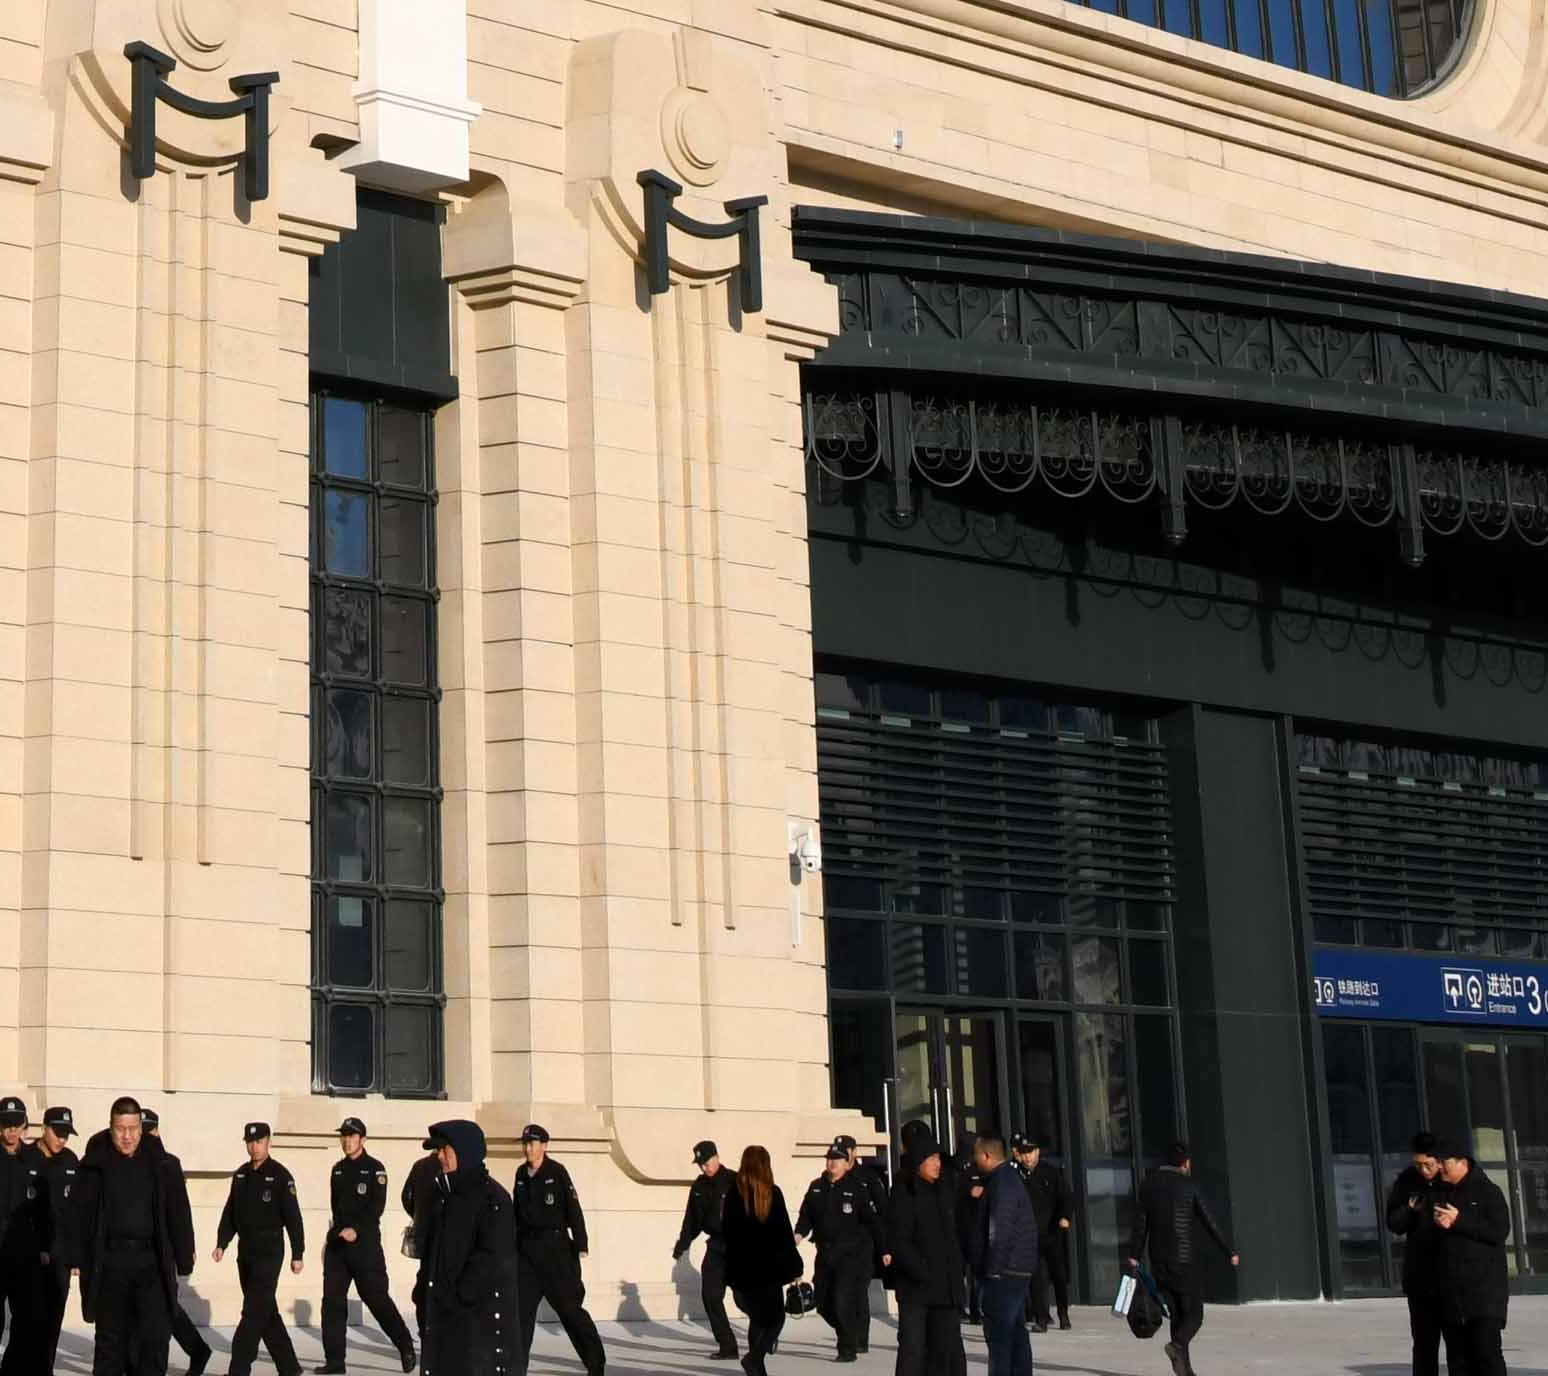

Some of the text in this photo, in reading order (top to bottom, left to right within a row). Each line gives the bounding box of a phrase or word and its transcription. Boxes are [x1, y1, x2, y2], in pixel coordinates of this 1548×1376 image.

[1487, 973, 1524, 997] 进站口
[1526, 975, 1542, 1015] 3
